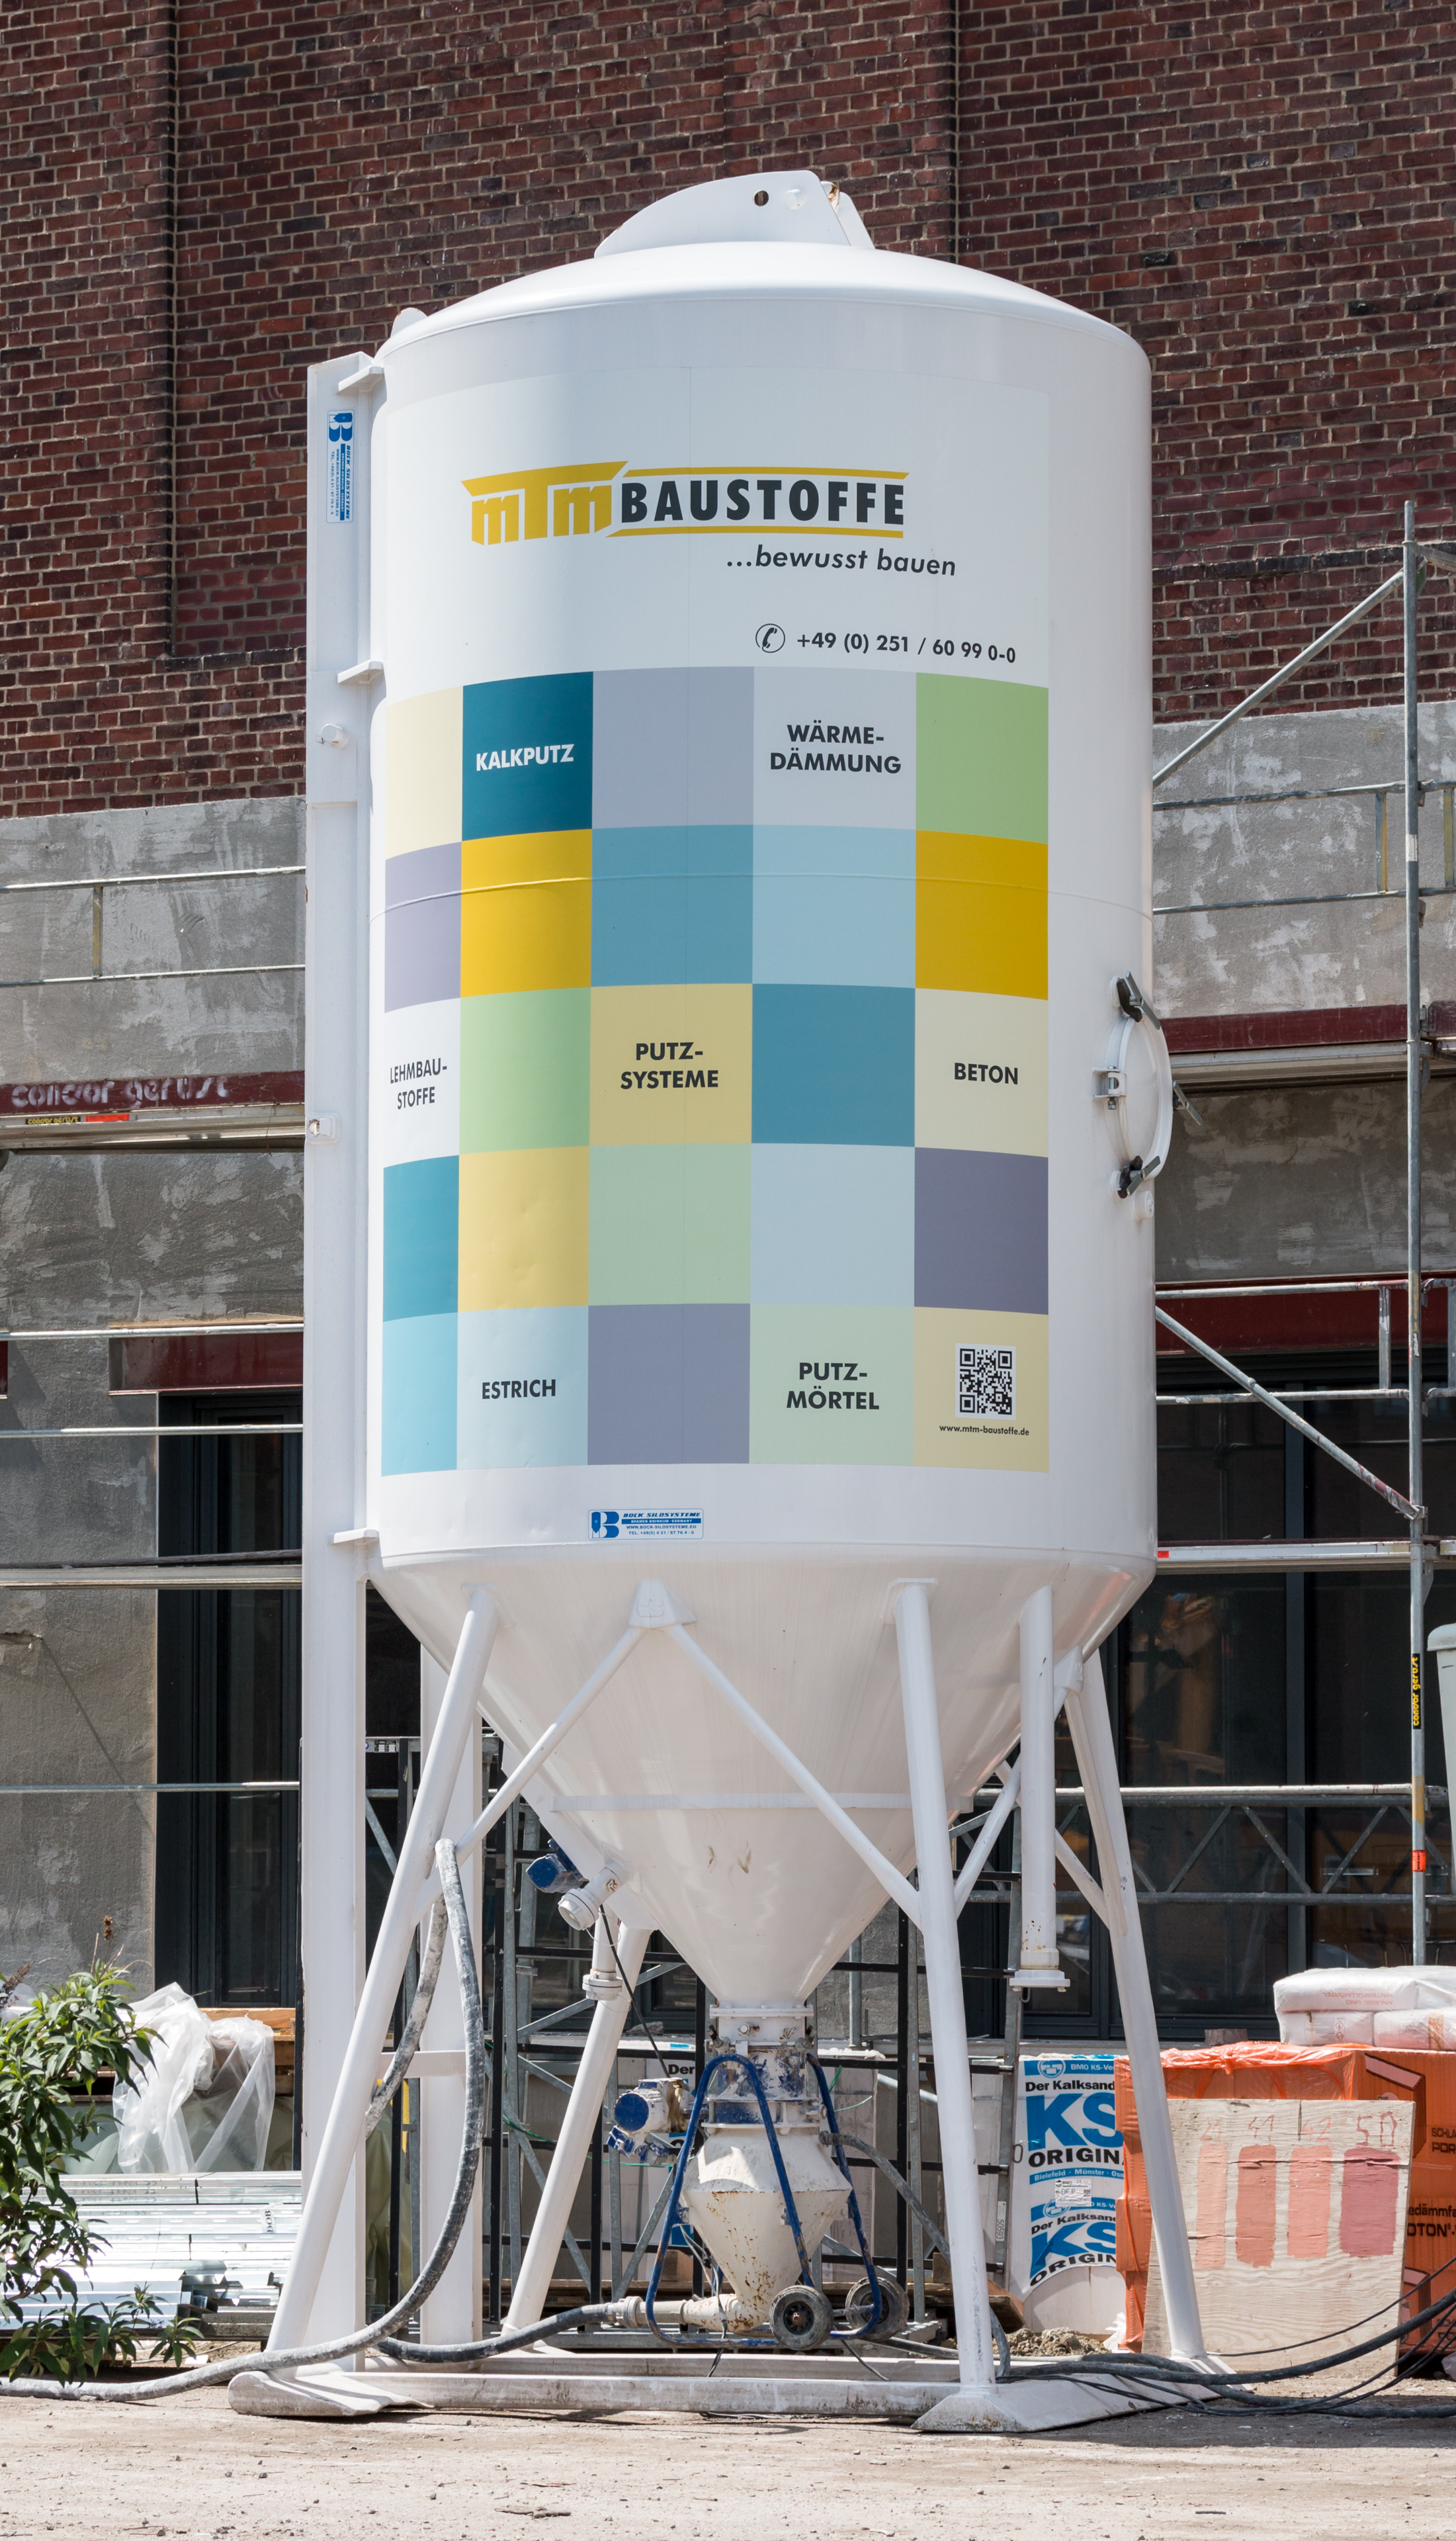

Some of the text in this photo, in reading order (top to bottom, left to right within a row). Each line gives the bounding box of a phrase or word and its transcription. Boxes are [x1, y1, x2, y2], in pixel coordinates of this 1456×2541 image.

[621, 479, 904, 525] BAUSTOFFE
[877, 548, 955, 576] bauen
[798, 633, 836, 648] +49
[844, 633, 869, 654] (0)
[877, 635, 908, 652] 251
[933, 639, 954, 656] 60
[961, 642, 982, 658] 99
[988, 645, 1015, 663] 0-0
[787, 720, 884, 744] WÄRME-
[476, 744, 574, 771] KALKPUTZ
[771, 748, 901, 774] DÄMMUNG
[636, 1042, 703, 1060] PUTZ-
[391, 1058, 447, 1083] LEHMBAU-
[621, 1070, 718, 1089] SYSTEME
[955, 1063, 1017, 1085] BETON
[398, 1087, 435, 1109] STOFFE
[800, 1362, 867, 1380] PUTZ-
[482, 1379, 556, 1399] ESTRICH
[787, 1386, 879, 1409] MÖRTEL
[939, 1425, 1029, 1435] www.mtm-baustoffe.de
[668, 2064, 695, 2074] Der
[1025, 2081, 1049, 2092] Der
[1026, 2092, 1124, 2151] KS
[1029, 2148, 1124, 2168] ORIGIN
[1035, 2170, 1066, 2181] Bielefeld
[1031, 2221, 1053, 2235] Der
[1029, 2221, 1116, 2279] KS
